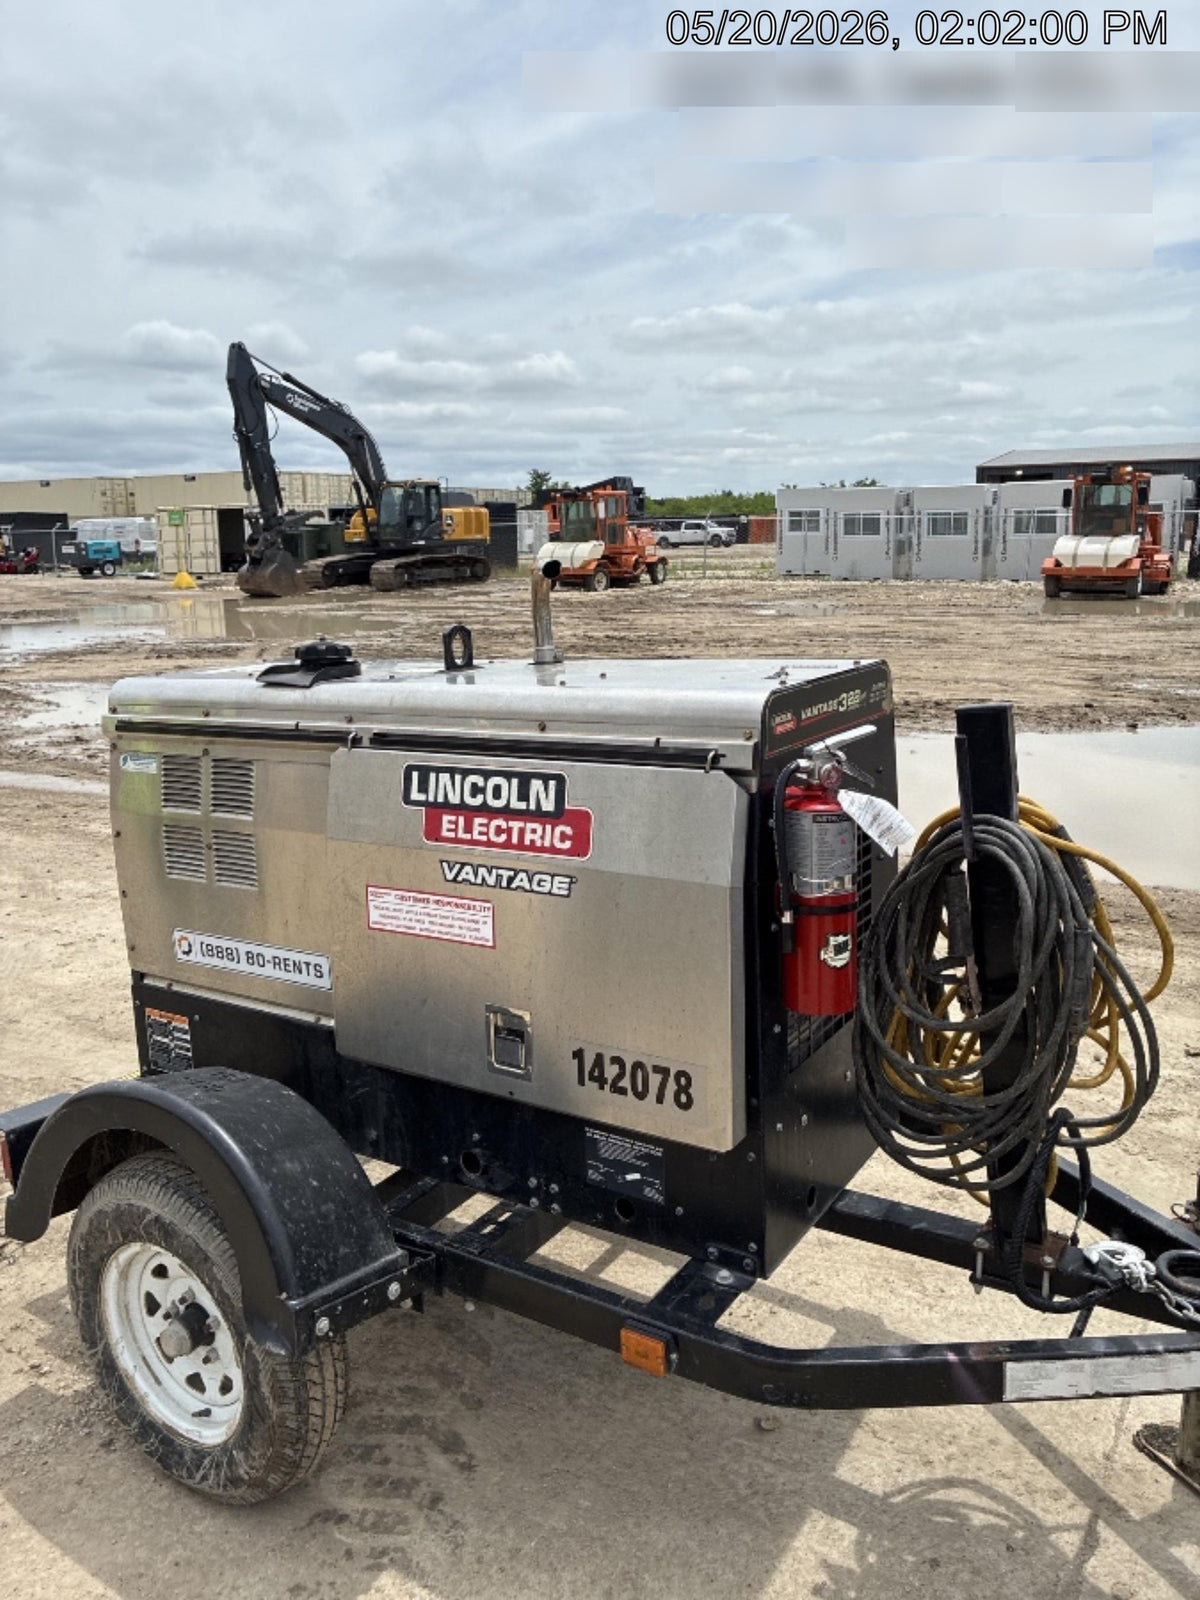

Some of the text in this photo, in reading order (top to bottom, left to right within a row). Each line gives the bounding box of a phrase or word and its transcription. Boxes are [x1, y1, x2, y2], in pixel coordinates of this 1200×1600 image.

[410, 771, 556, 812] LINCOLN
[440, 814, 573, 849] ELECTRIC
[440, 860, 572, 897] VANTAGE
[200, 941, 240, 964] (888)
[571, 1047, 694, 1111] 142078
